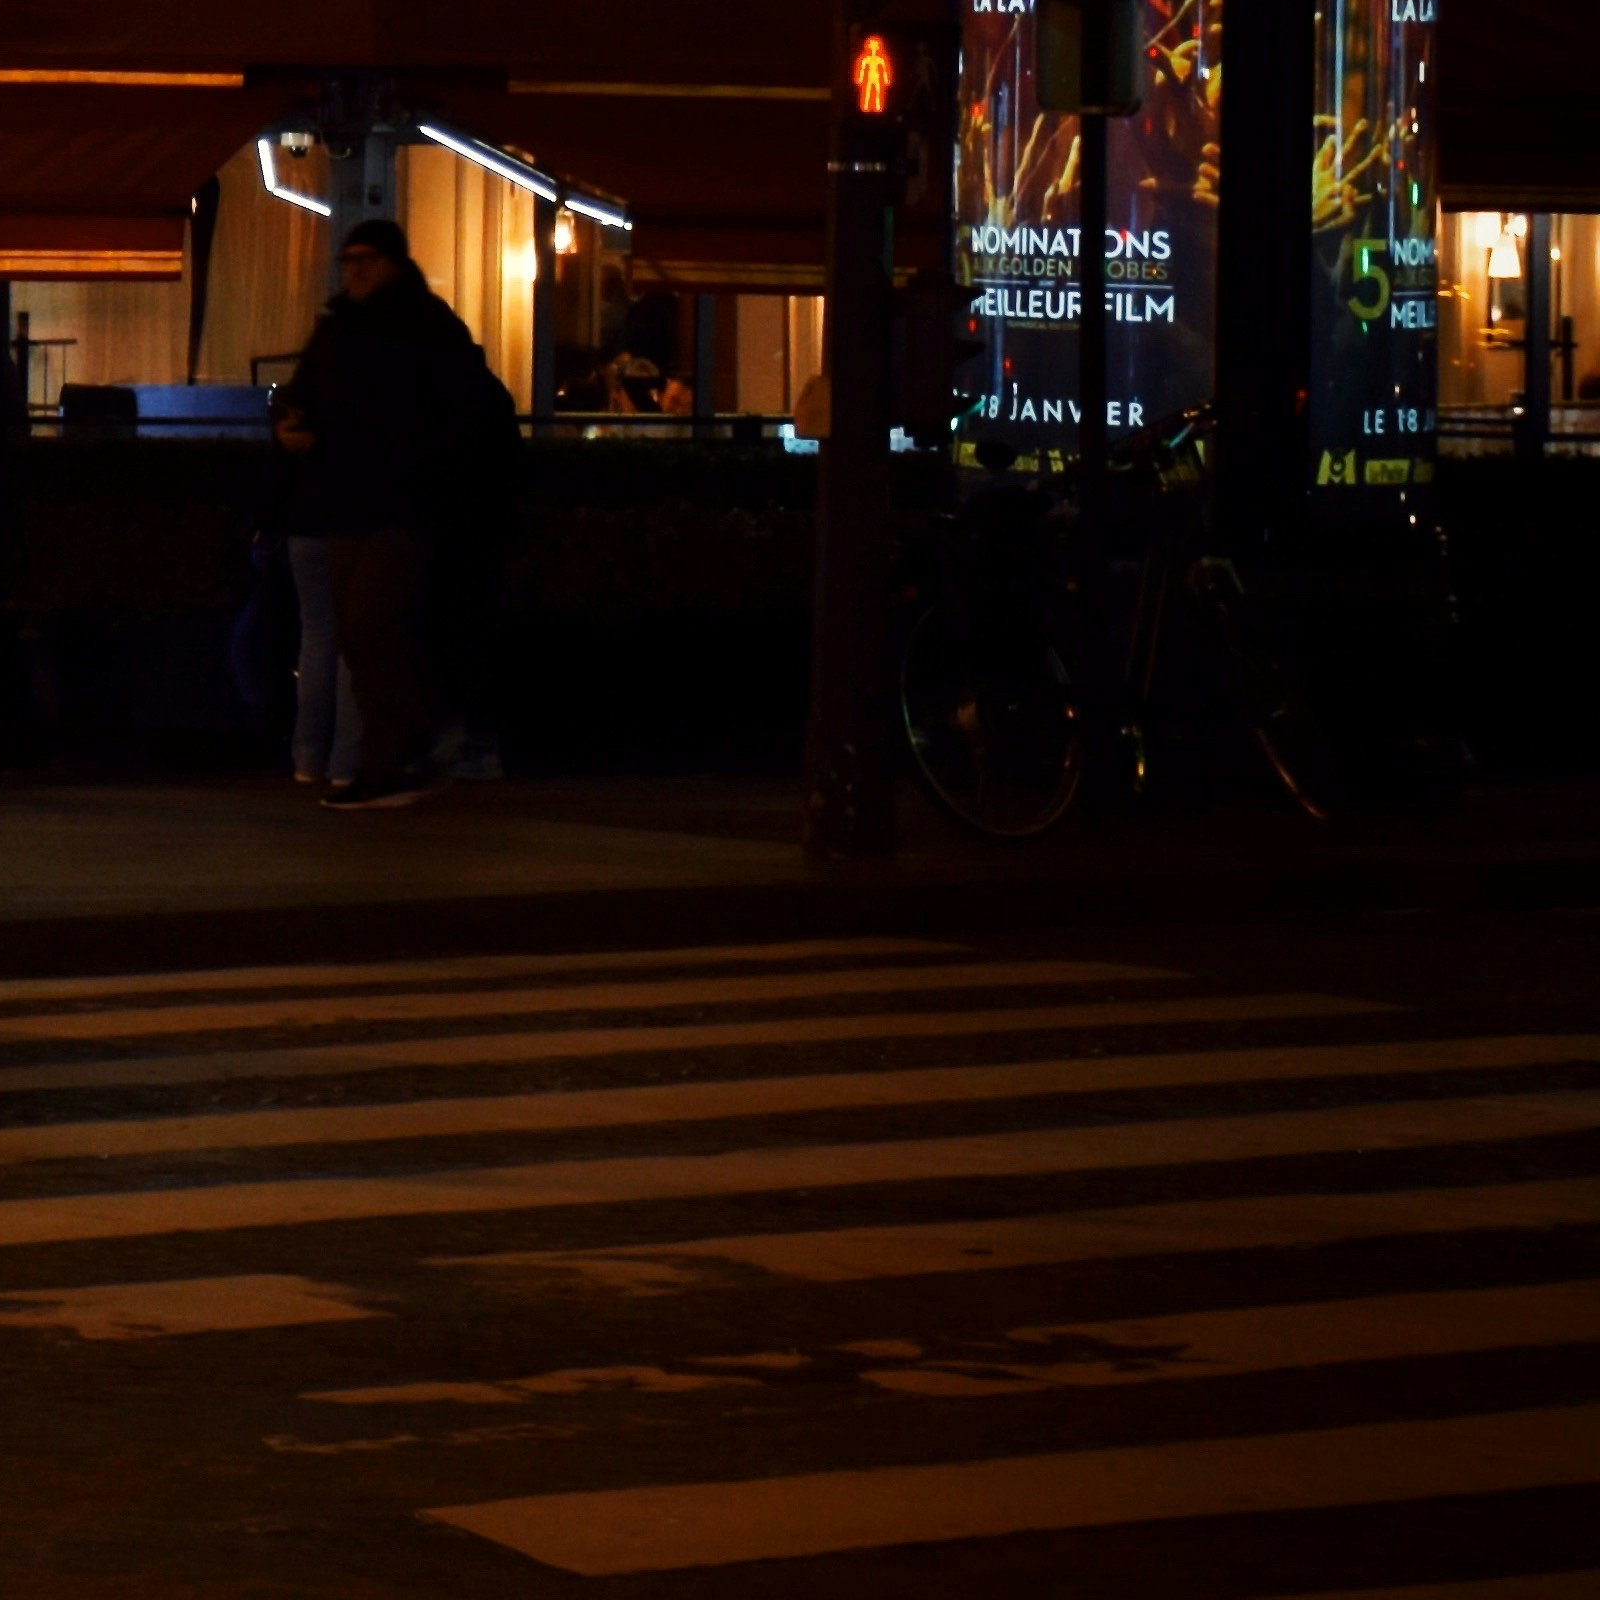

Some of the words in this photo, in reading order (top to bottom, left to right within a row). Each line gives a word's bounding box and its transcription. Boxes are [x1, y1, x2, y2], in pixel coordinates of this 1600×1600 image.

[971, 226, 1172, 260] NOMINATONS
[999, 257, 1073, 277] GOLDEN
[1106, 260, 1168, 281] OBES
[1349, 238, 1391, 321] 5
[1009, 394, 1144, 427] JANVER
[1363, 408, 1386, 436] LE
